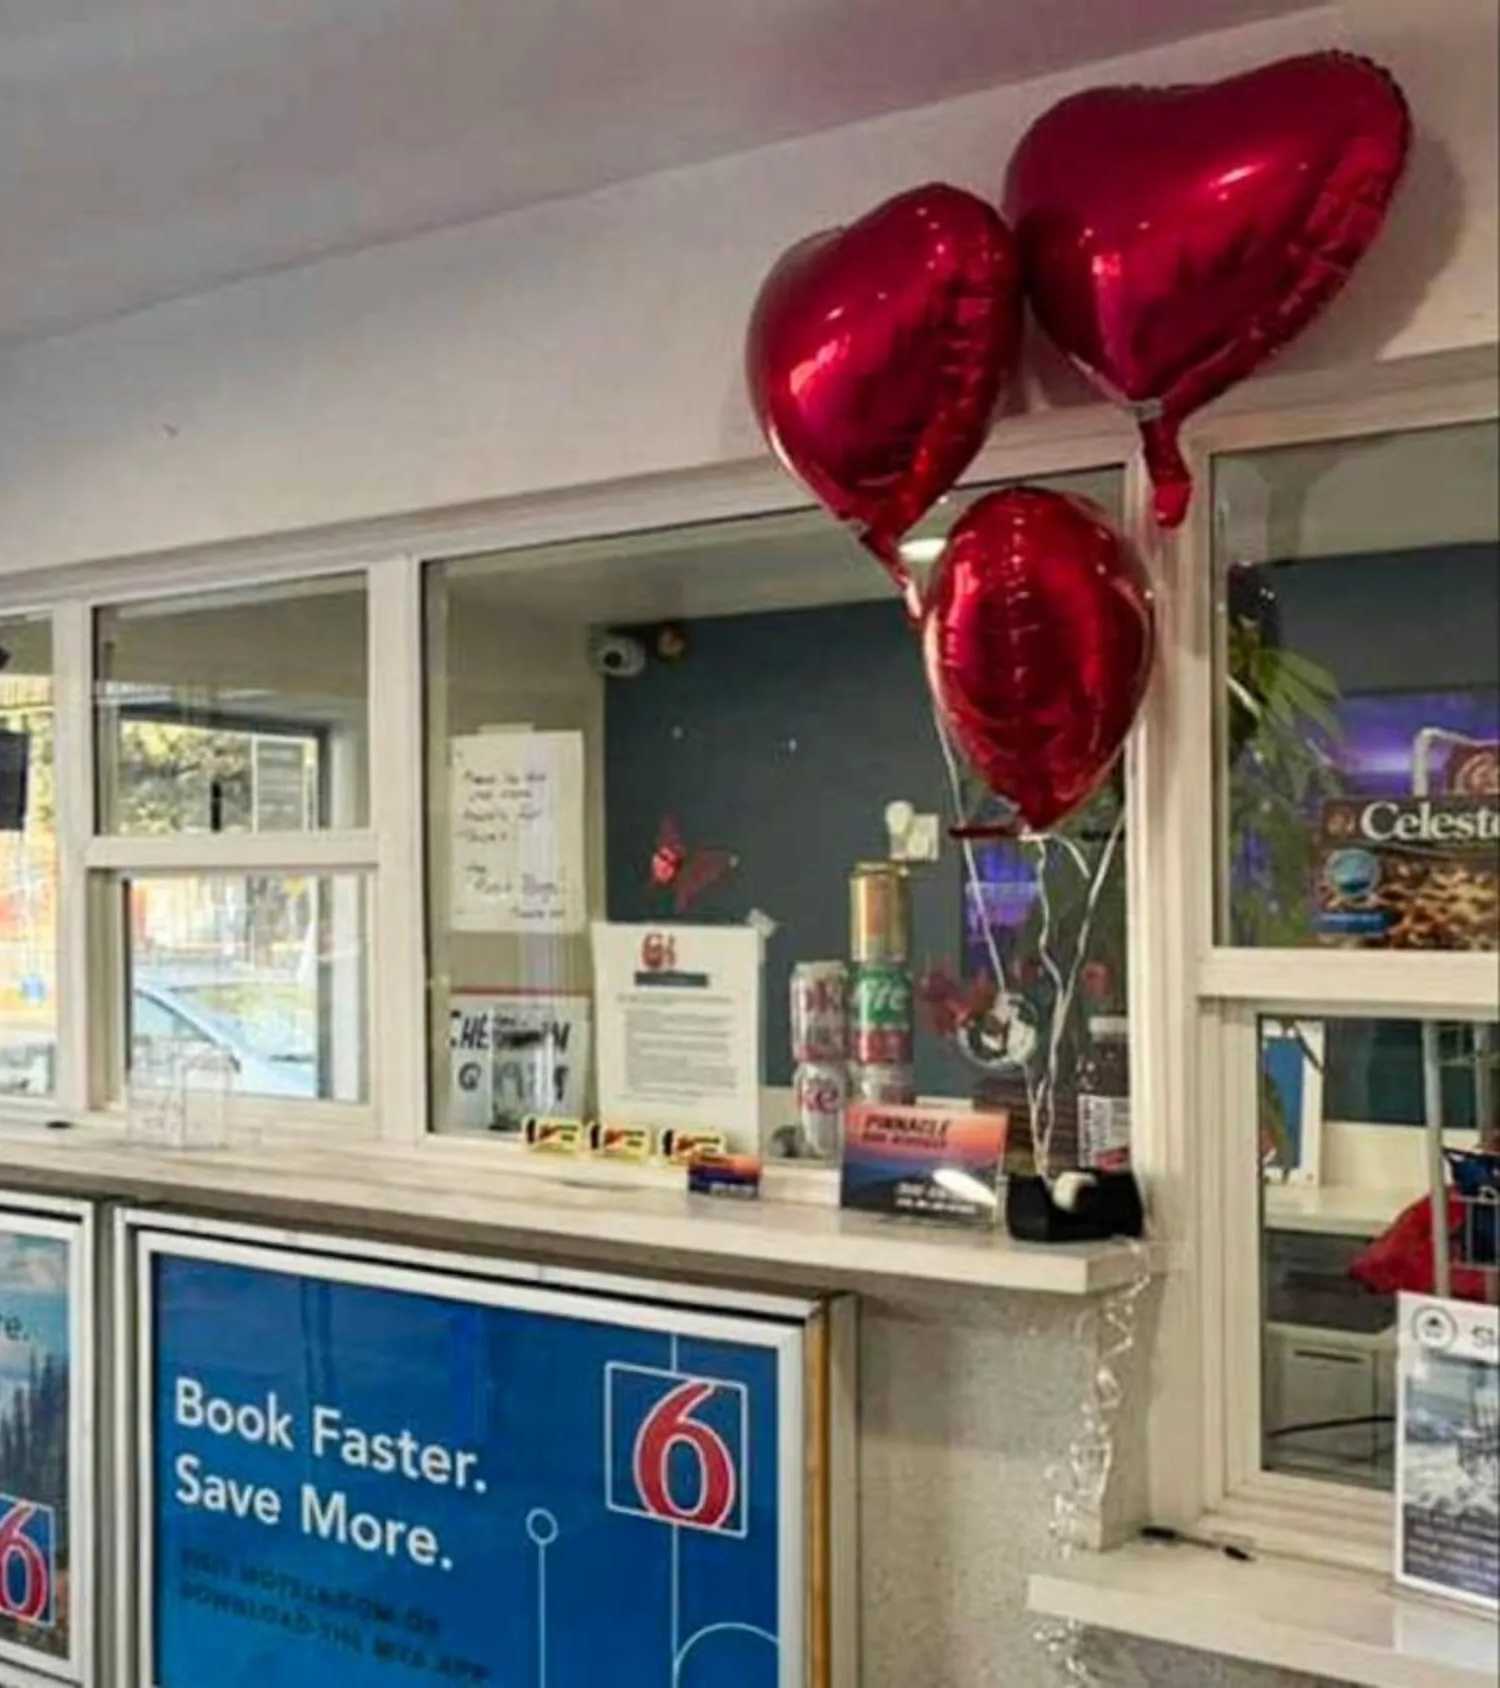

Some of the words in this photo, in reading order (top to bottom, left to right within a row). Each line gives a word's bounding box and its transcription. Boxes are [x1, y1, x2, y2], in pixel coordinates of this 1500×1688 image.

[175, 1376, 294, 1450] Book
[312, 1404, 488, 1494] Faster.
[632, 1378, 737, 1530] 6
[175, 1453, 282, 1525] Save
[300, 1483, 453, 1570] More.
